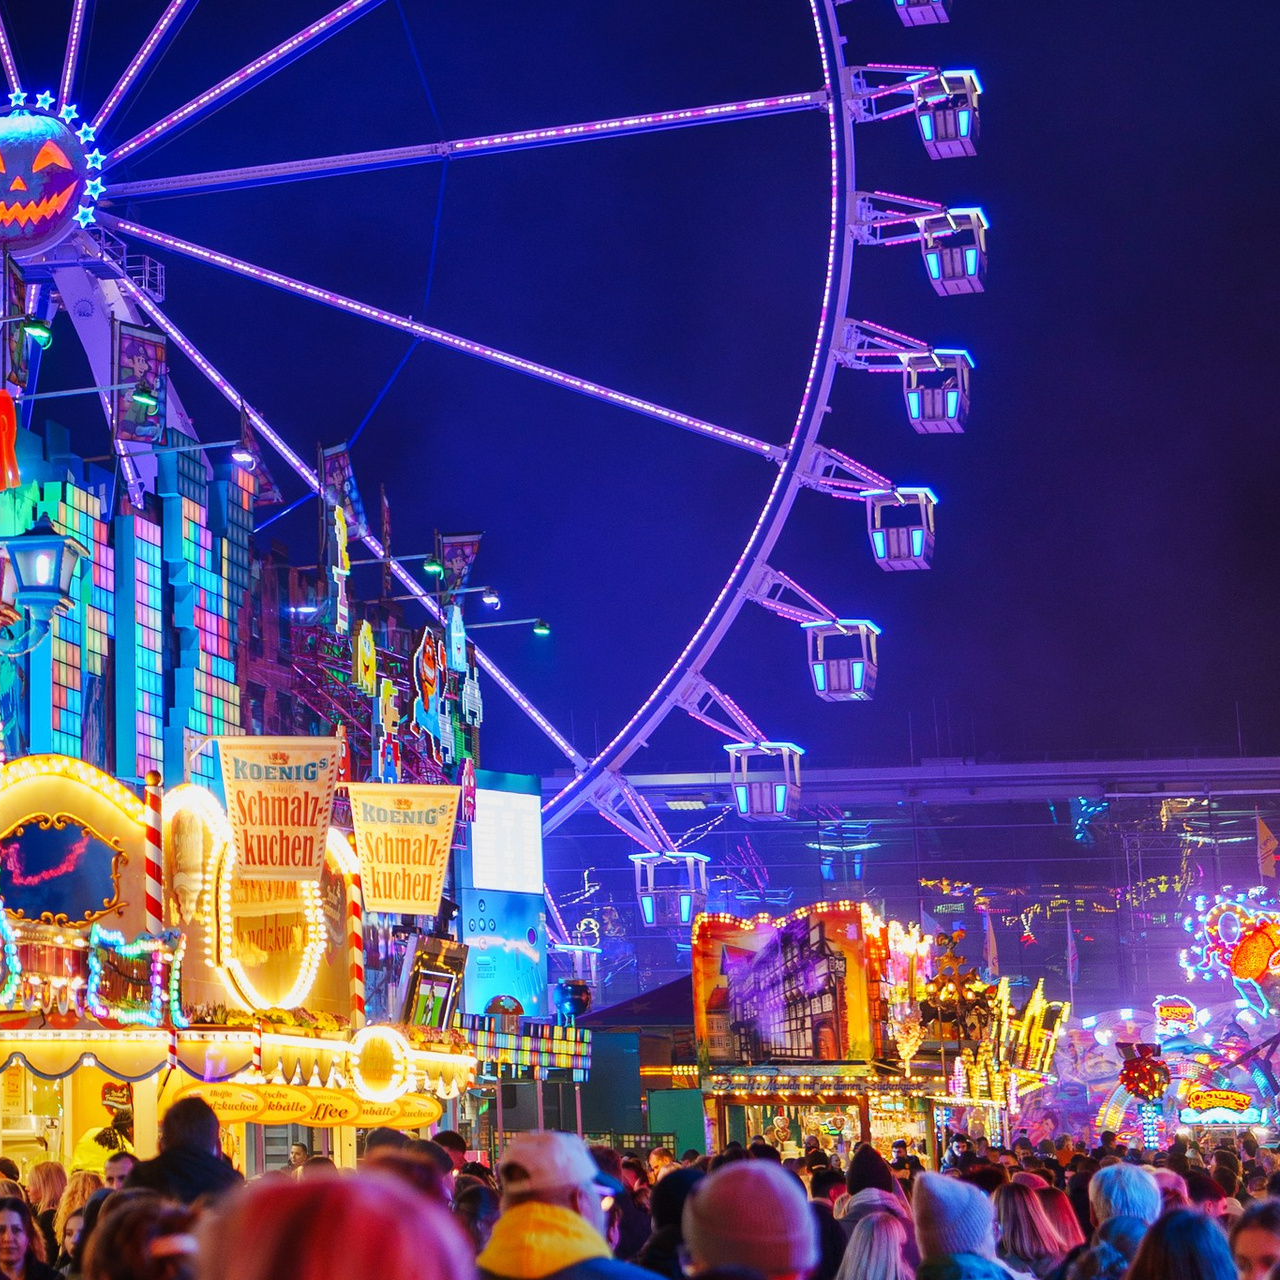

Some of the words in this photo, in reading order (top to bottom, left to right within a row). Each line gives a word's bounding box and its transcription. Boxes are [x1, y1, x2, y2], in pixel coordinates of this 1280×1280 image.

[236, 789, 324, 827] Schmalz-
[242, 829, 315, 867] kuchen
[364, 831, 441, 866] Schmalz-
[371, 866, 432, 902] kuchen
[267, 1101, 307, 1113] kbälle
[309, 1102, 349, 1120] ffee
